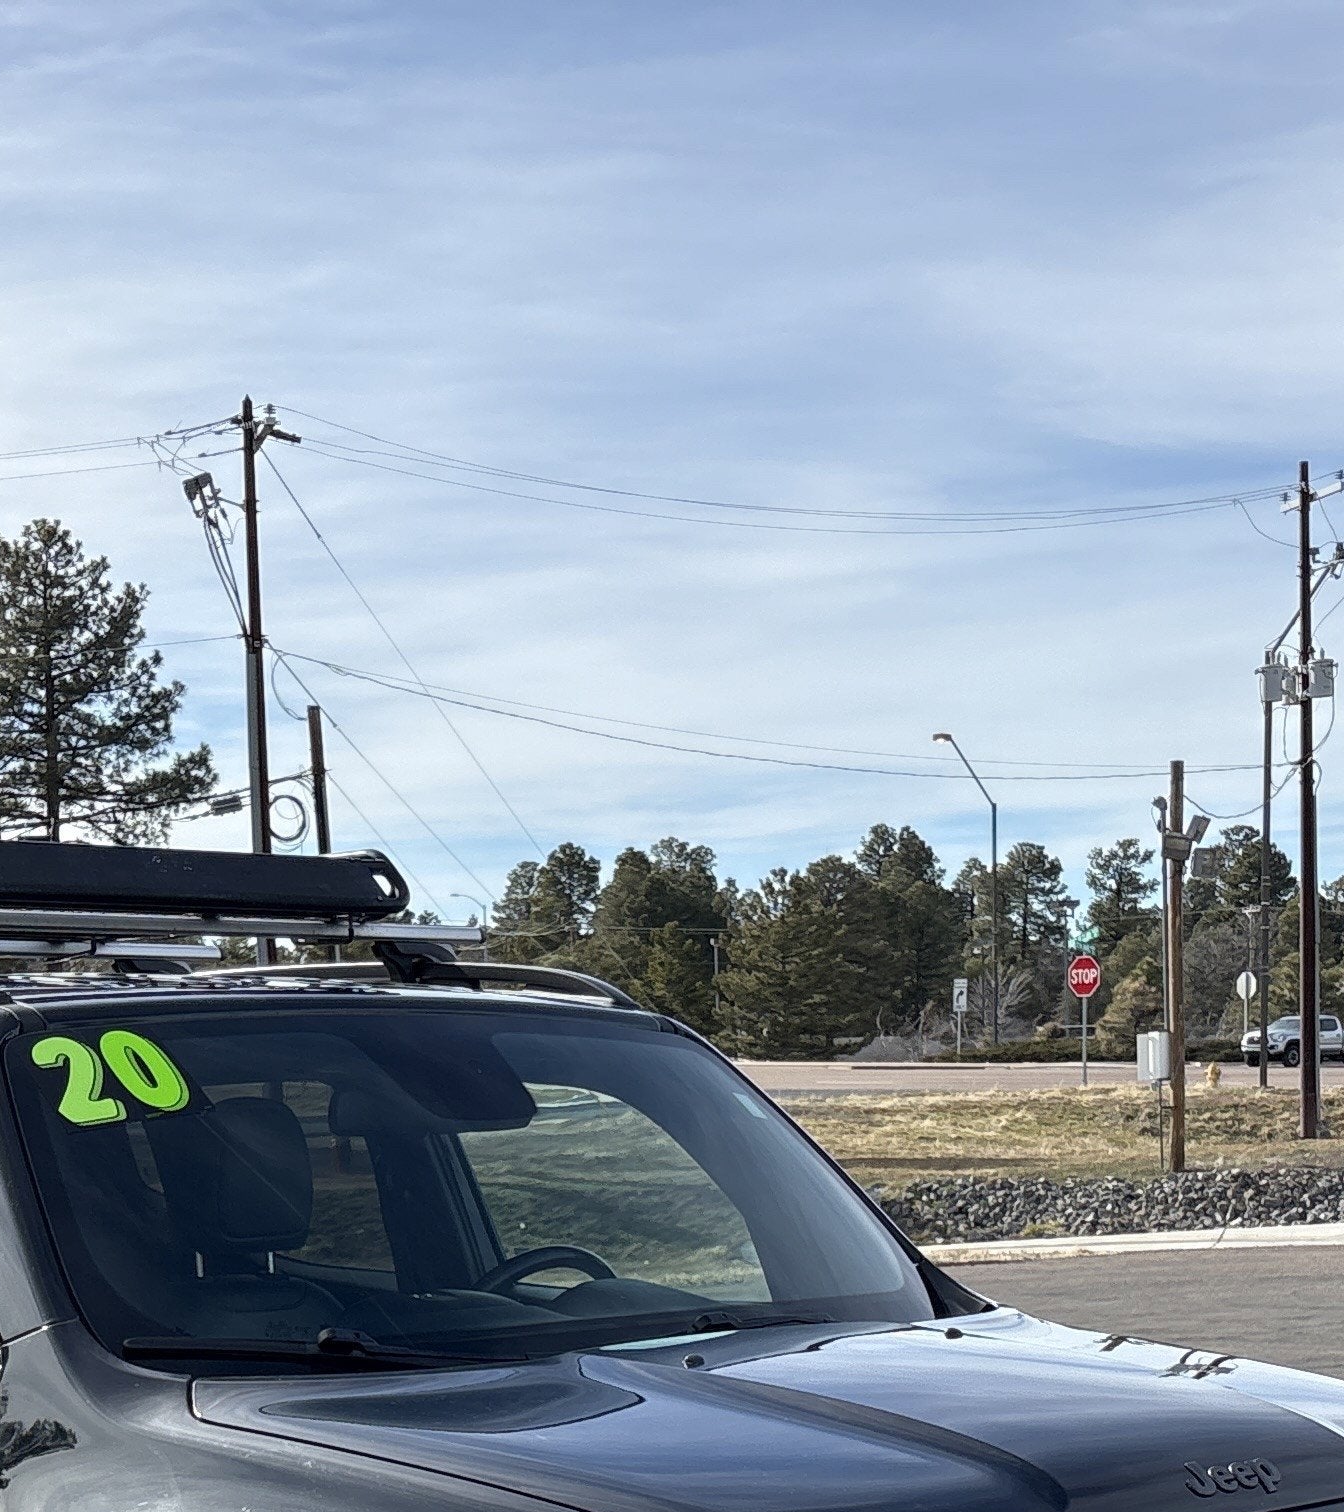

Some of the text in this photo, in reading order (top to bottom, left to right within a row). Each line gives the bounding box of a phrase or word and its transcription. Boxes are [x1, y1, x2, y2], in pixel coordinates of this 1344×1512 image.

[1071, 968, 1098, 985] STOP
[31, 1030, 190, 1127] 20
[1183, 1458, 1281, 1498] Jeep
